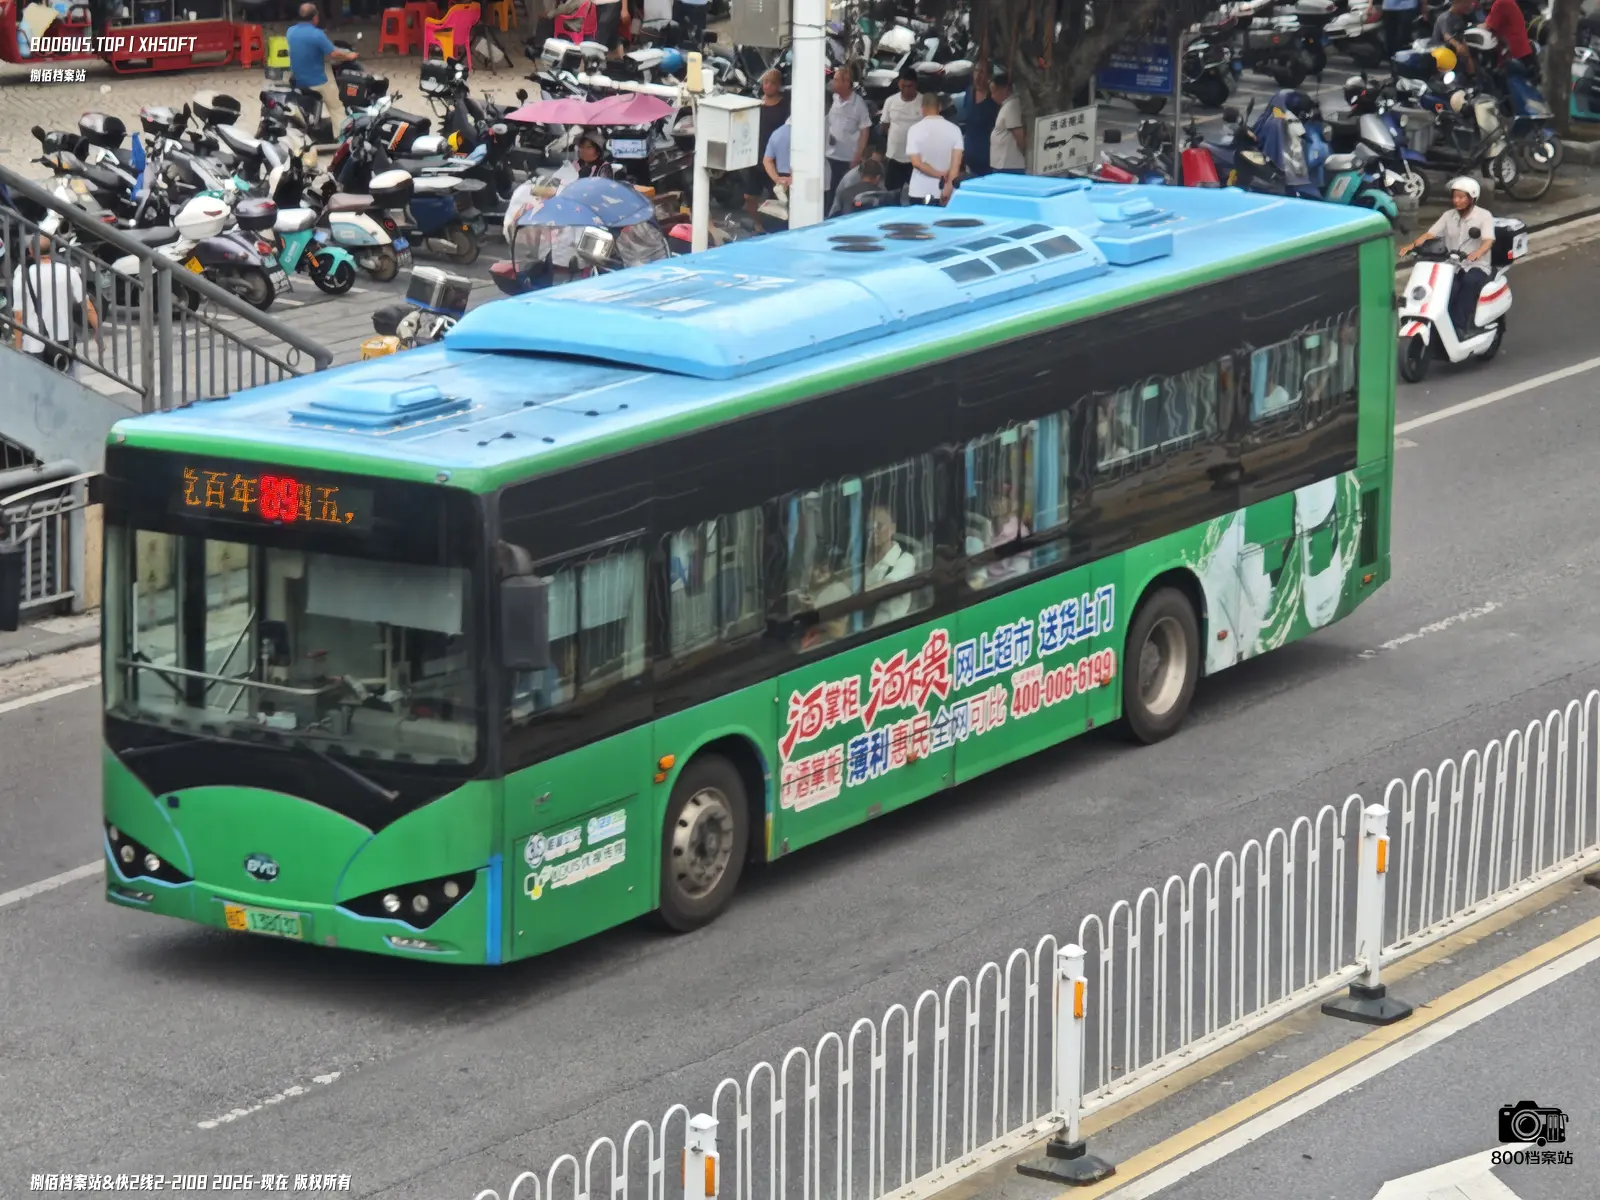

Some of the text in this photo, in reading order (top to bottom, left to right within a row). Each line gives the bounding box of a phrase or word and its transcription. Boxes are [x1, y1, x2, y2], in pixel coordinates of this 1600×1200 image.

[260, 474, 299, 522] 89
[780, 678, 860, 759] 酒掌柜
[957, 623, 1032, 688] 网上超市
[1040, 586, 1114, 654] 送货上门
[1012, 652, 1113, 715] 400-006-6199
[247, 859, 277, 876] BYD
